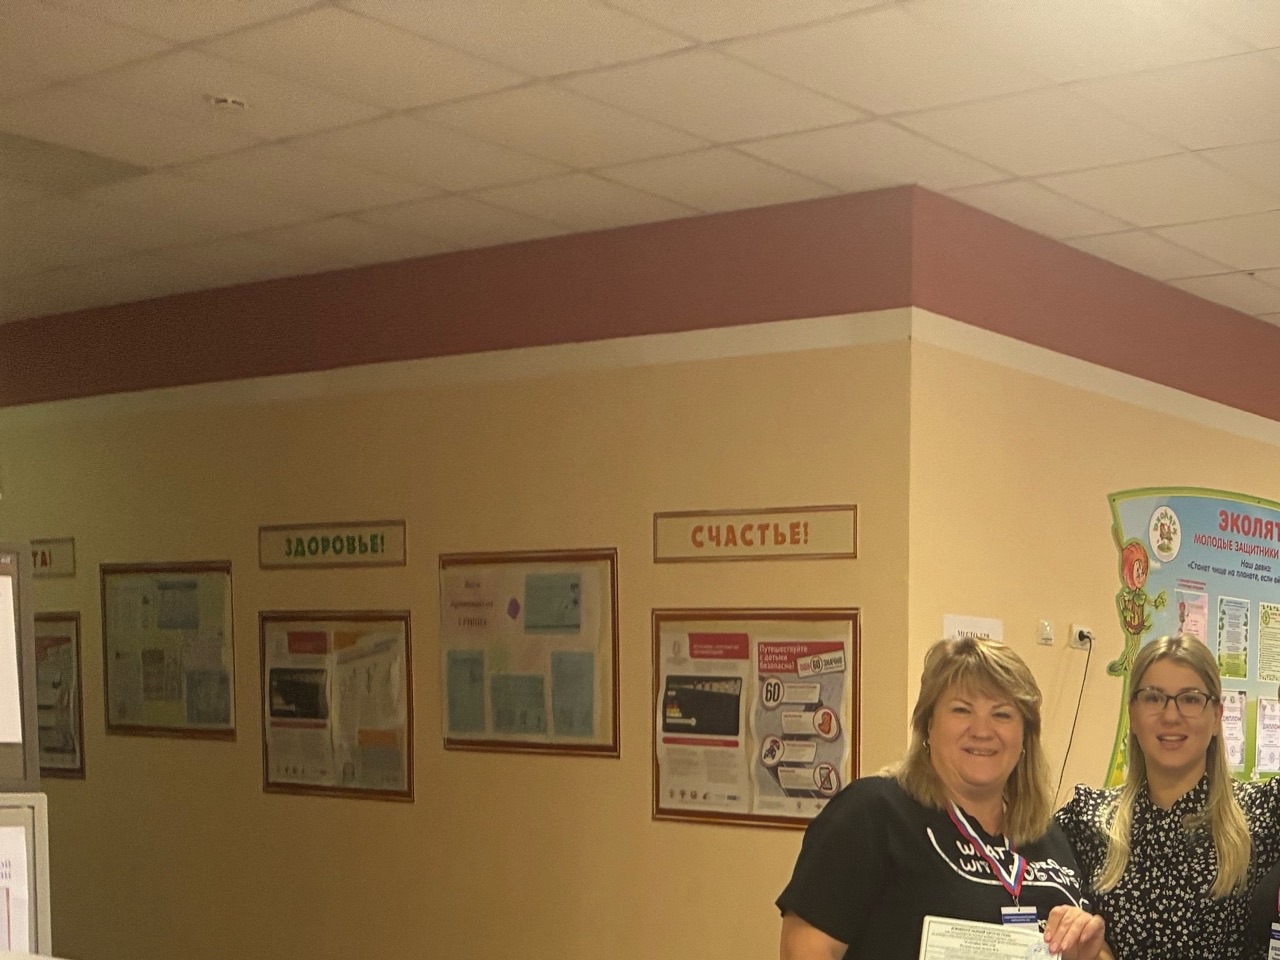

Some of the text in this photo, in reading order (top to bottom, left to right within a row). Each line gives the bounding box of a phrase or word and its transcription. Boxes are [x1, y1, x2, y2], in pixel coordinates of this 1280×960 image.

[285, 533, 384, 557] ЗДОРОВЬЕ!
[691, 521, 808, 548] СЧАСТЬЕ!
[1193, 533, 1233, 551] МОЛОДЫЕ
[1234, 541, 1279, 560] ЗАЩИТНИКИ
[1240, 560, 1254, 571] Наш
[759, 644, 808, 655] Путешествуйте
[765, 682, 780, 702] 60
